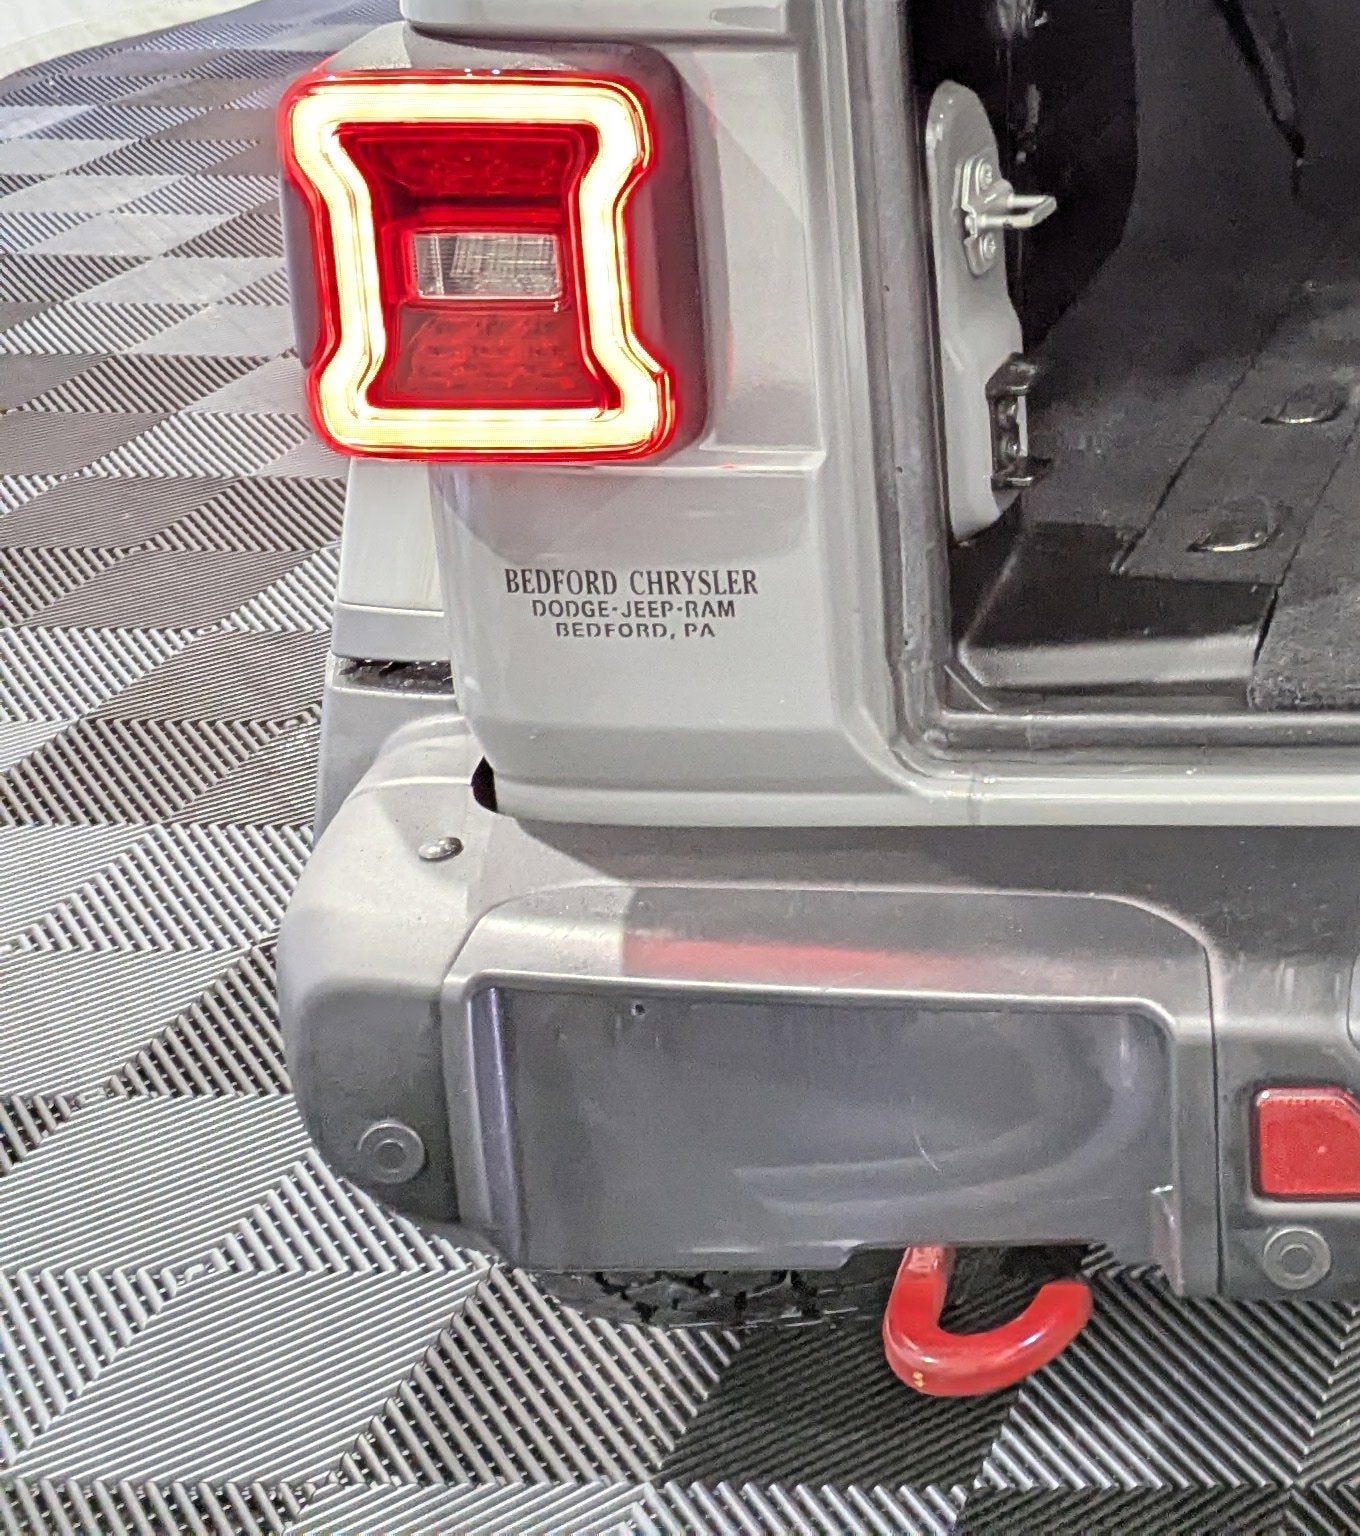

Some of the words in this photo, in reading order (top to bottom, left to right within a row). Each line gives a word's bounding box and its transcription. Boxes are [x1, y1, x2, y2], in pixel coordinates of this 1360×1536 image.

[504, 568, 618, 595] BEDFORD
[629, 569, 759, 596] CHRYSLER
[555, 621, 675, 640] BEDFORD,
[684, 622, 716, 638] PA
